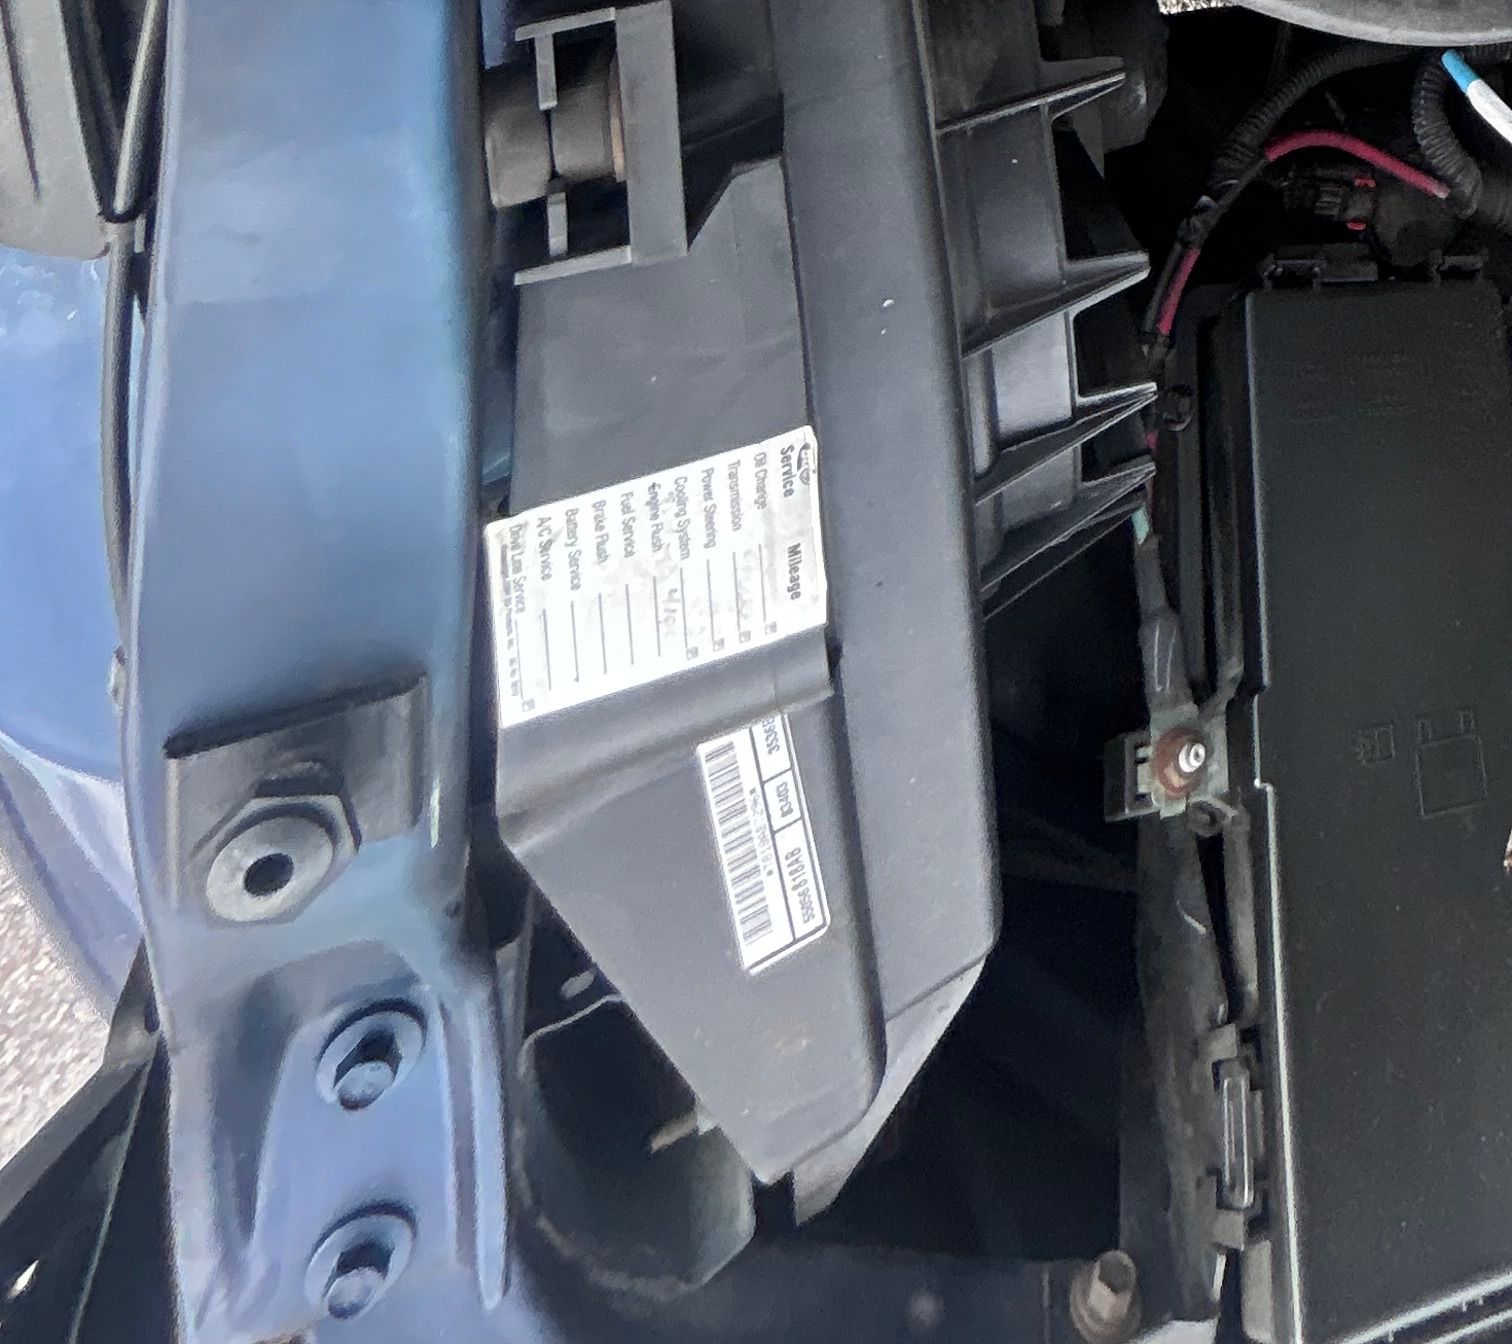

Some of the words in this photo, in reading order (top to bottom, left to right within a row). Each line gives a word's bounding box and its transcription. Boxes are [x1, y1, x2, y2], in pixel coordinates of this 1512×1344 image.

[701, 467, 714, 503] Power
[753, 468, 768, 511] Change
[780, 444, 796, 498] Service
[592, 499, 606, 533] Brake
[620, 492, 634, 515] Fuel
[645, 484, 661, 521] Engine
[674, 476, 688, 519] Cooling
[728, 459, 743, 532] Transmission
[536, 516, 552, 537] A/C
[564, 508, 580, 548] Battery
[622, 515, 636, 558] Service
[651, 521, 664, 553] Flush
[673, 518, 691, 561] System
[703, 503, 717, 549] Steering
[539, 538, 554, 582] Service
[567, 548, 583, 592] Service
[596, 532, 611, 565] Flush
[787, 542, 802, 601] Mileage
[512, 575, 528, 614] Service
[783, 846, 816, 925] 55056818AB
